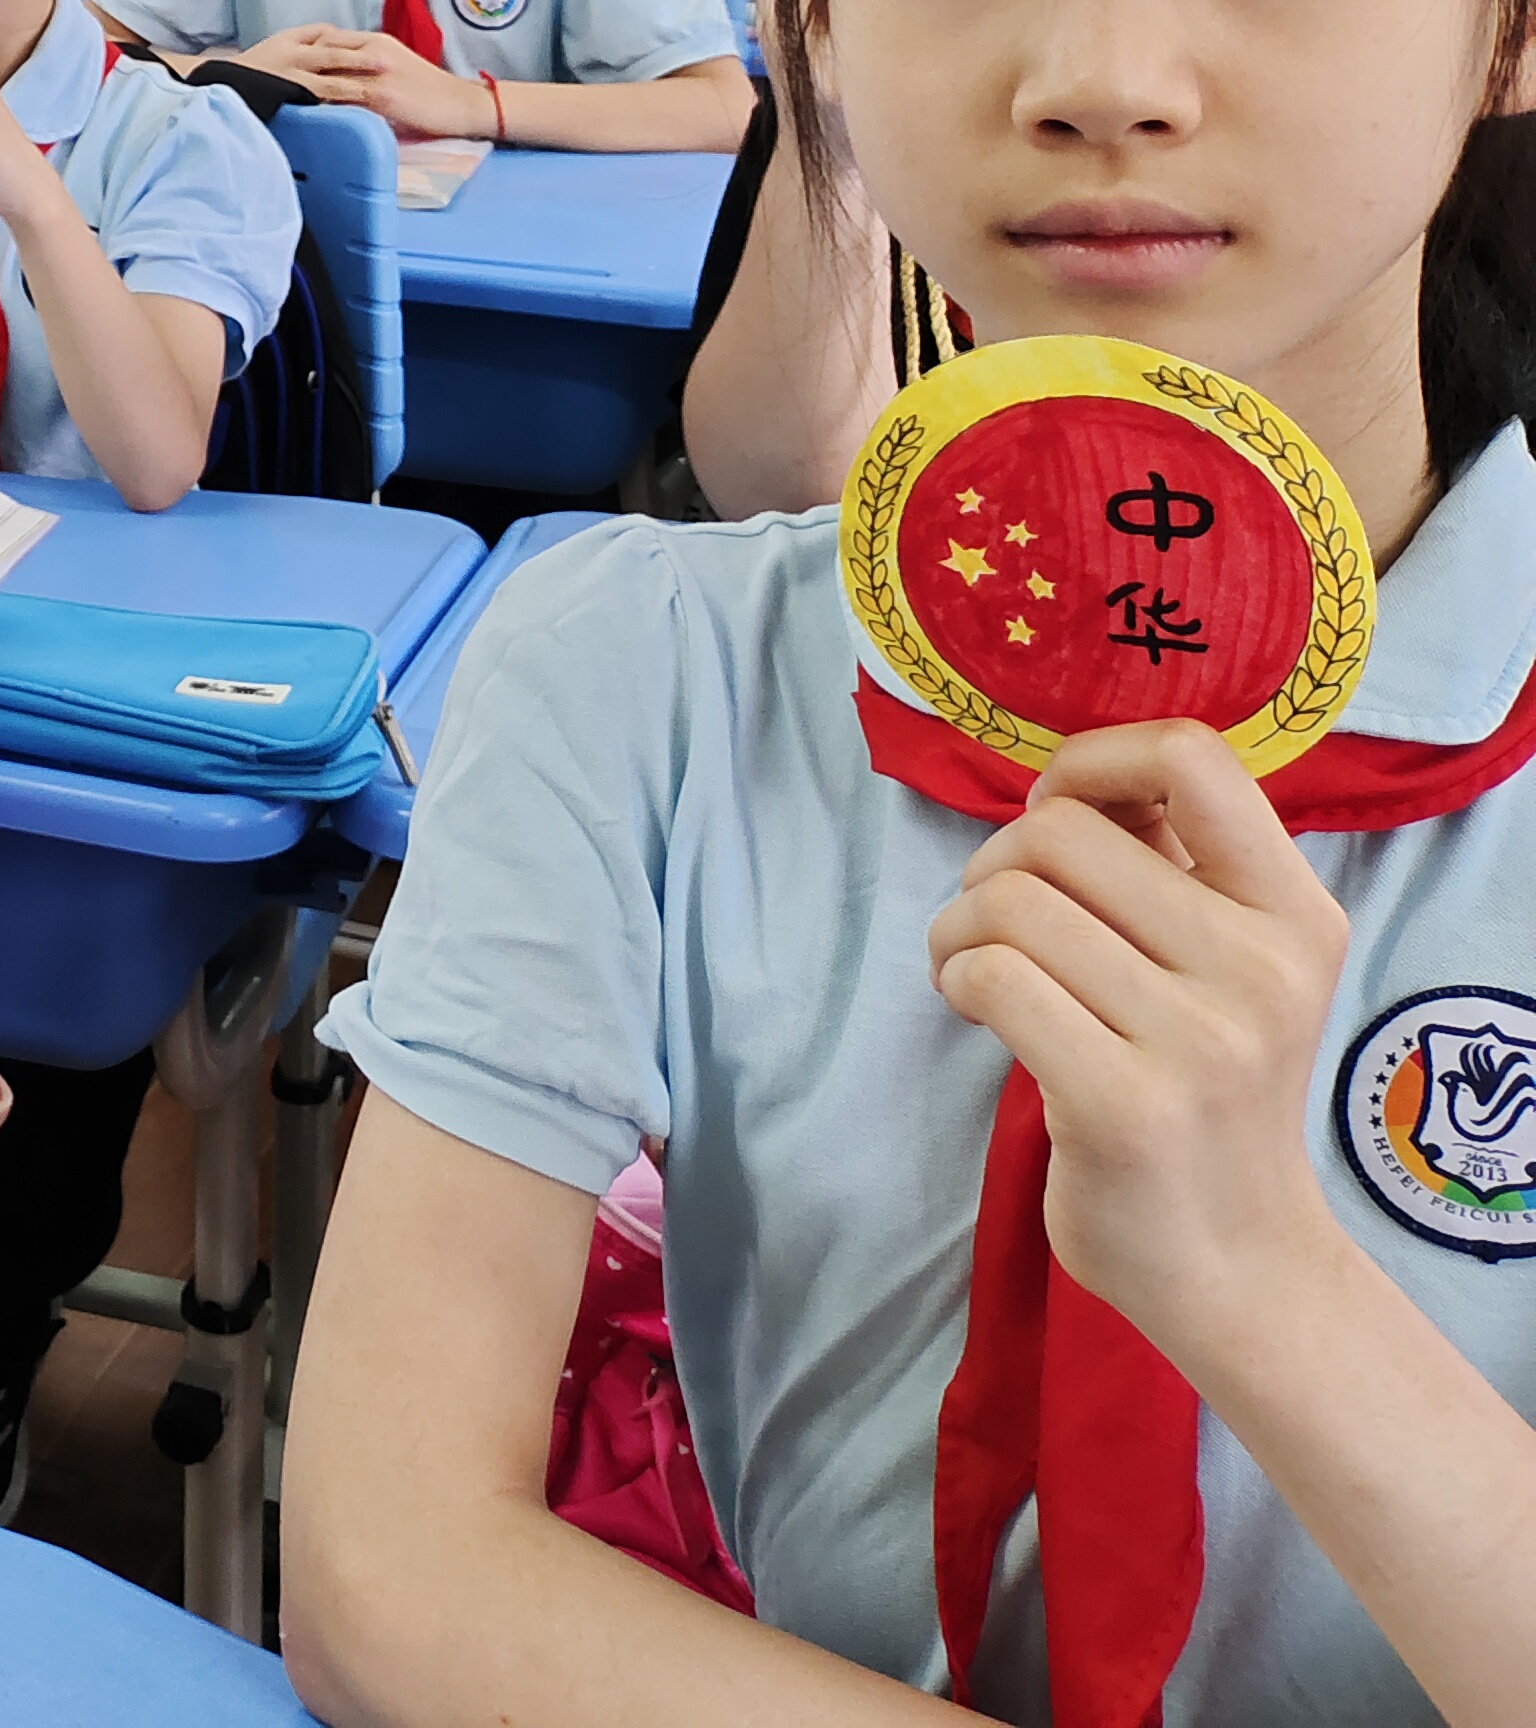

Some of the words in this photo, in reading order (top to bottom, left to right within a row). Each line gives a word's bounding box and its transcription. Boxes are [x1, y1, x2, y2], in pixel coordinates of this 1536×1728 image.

[1105, 471, 1216, 666] 中华
[1372, 1136, 1425, 1196] HEFEI
[1428, 1195, 1512, 1224] FEICUI
[1458, 1160, 1509, 1183] 2013
